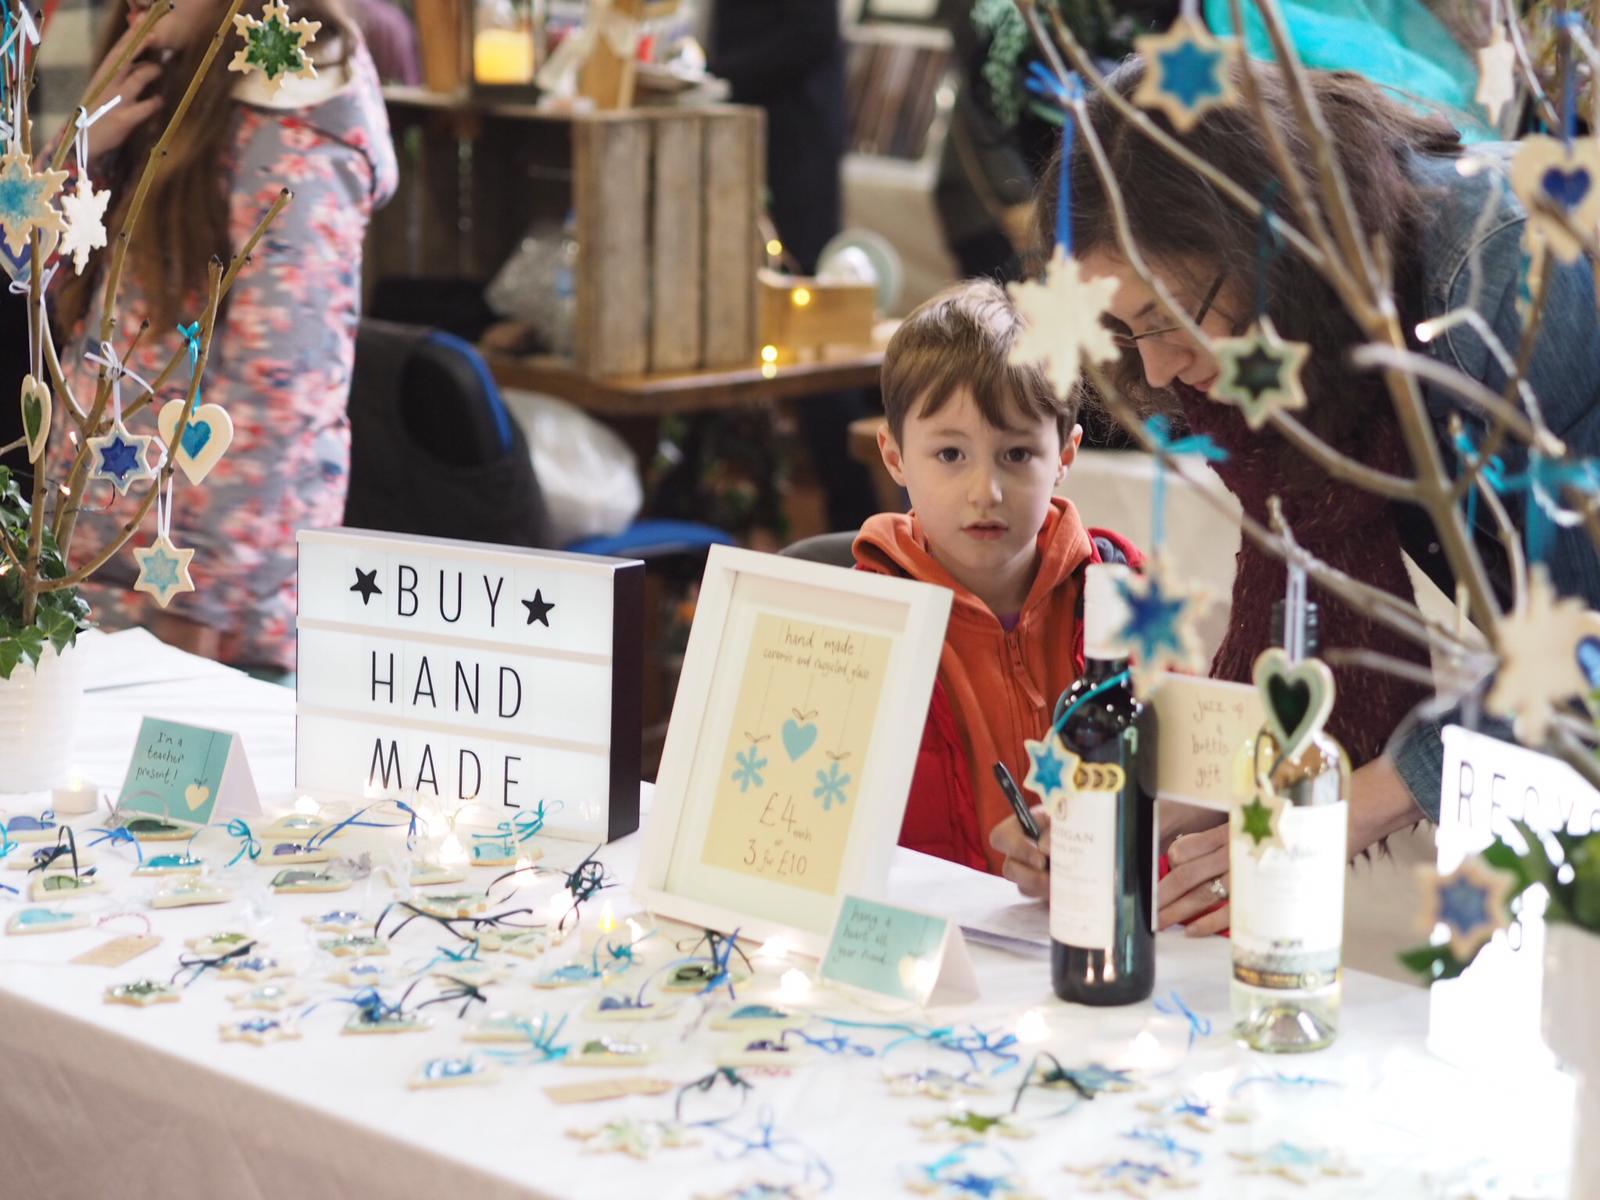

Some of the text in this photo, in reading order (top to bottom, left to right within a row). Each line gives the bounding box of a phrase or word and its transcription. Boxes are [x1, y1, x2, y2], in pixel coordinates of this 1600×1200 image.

[398, 564, 504, 628] BUY
[785, 625, 854, 656] hand made
[371, 650, 522, 718] HAND
[147, 745, 184, 764] teacher
[158, 732, 182, 747] I'm a
[136, 766, 178, 787] present!
[369, 738, 522, 808] MADE
[759, 792, 797, 832] £4
[743, 838, 757, 866] 3
[777, 850, 808, 876] £10
